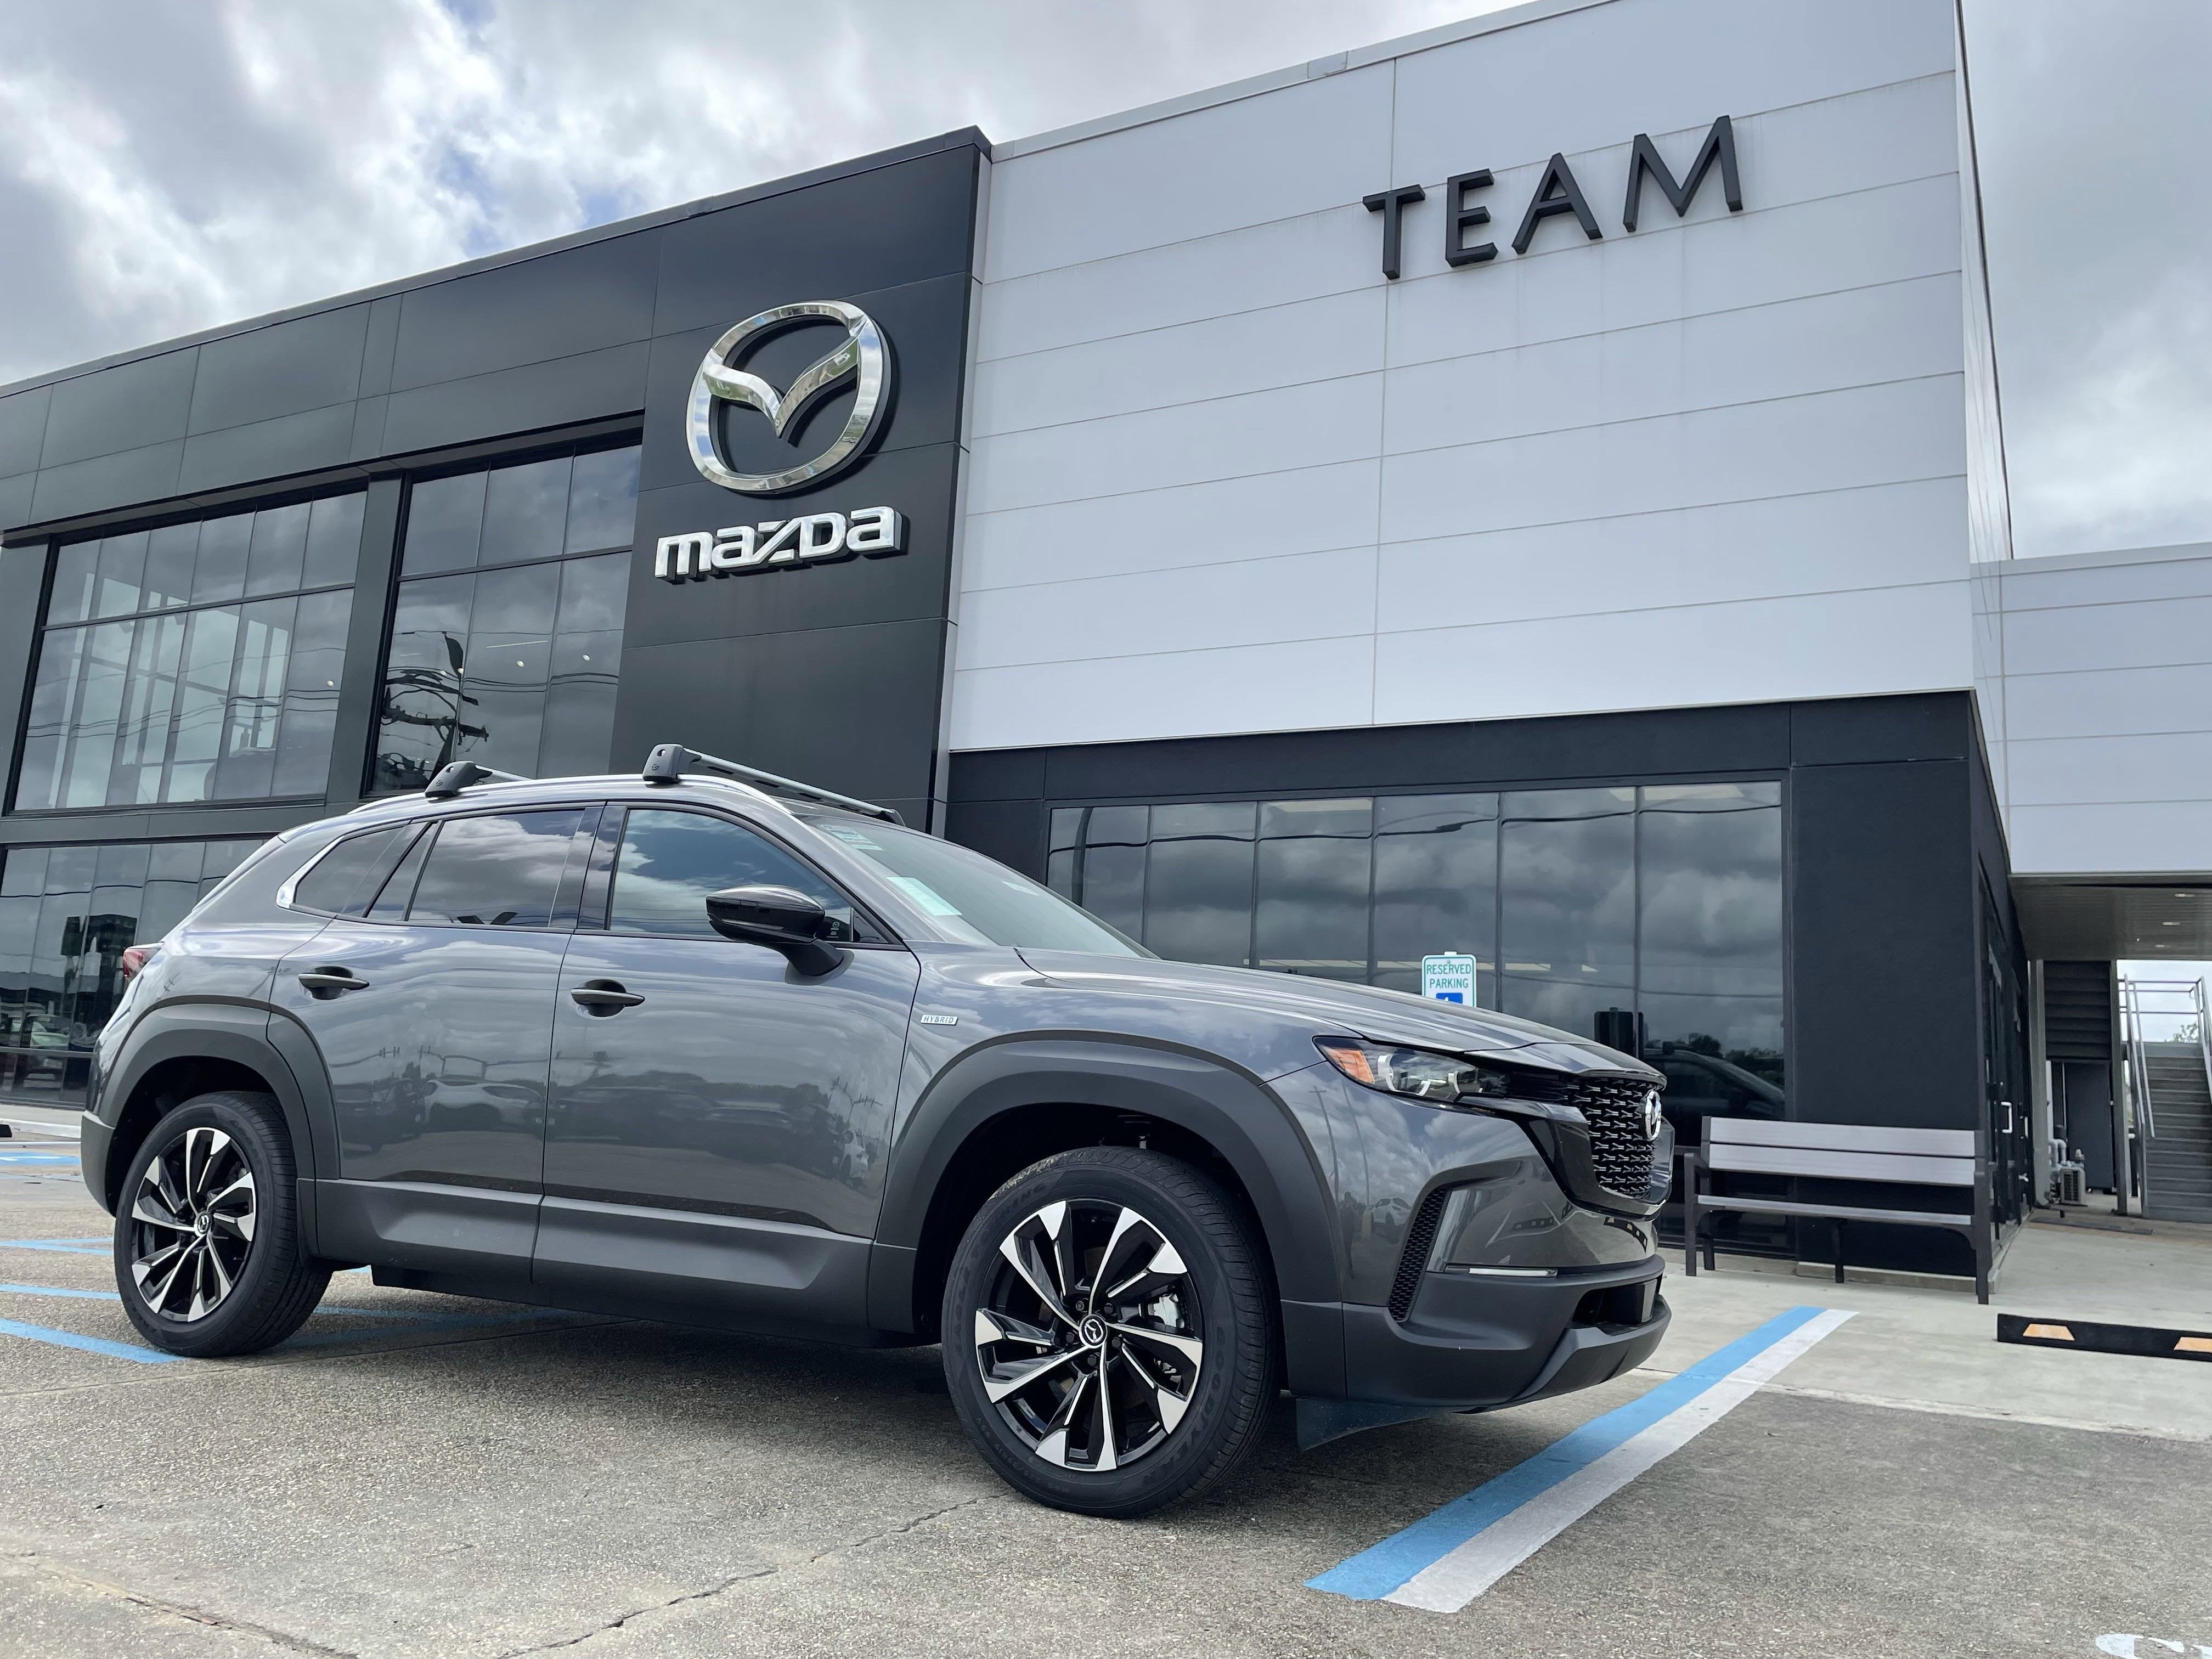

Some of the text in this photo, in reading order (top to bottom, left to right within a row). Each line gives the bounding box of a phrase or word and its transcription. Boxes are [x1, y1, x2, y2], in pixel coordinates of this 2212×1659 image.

[1363, 115, 1743, 280] TEAM
[1426, 964, 1471, 974] RESERVED
[1429, 978, 1469, 988] PARKING
[923, 1015, 954, 1024] HYBRID
